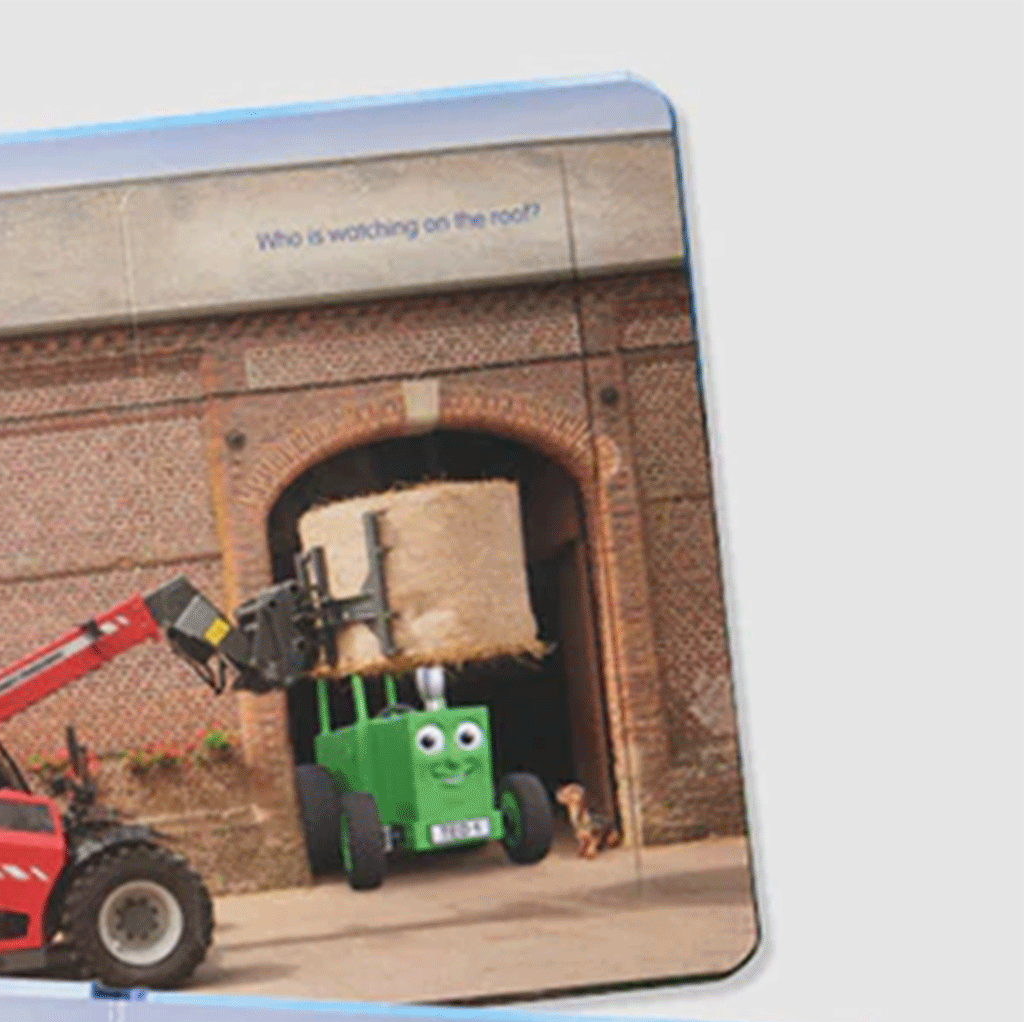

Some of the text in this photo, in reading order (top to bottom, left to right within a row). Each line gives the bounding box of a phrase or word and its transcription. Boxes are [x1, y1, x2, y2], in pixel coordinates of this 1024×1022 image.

[256, 201, 541, 251] Who is watching on the roof?
